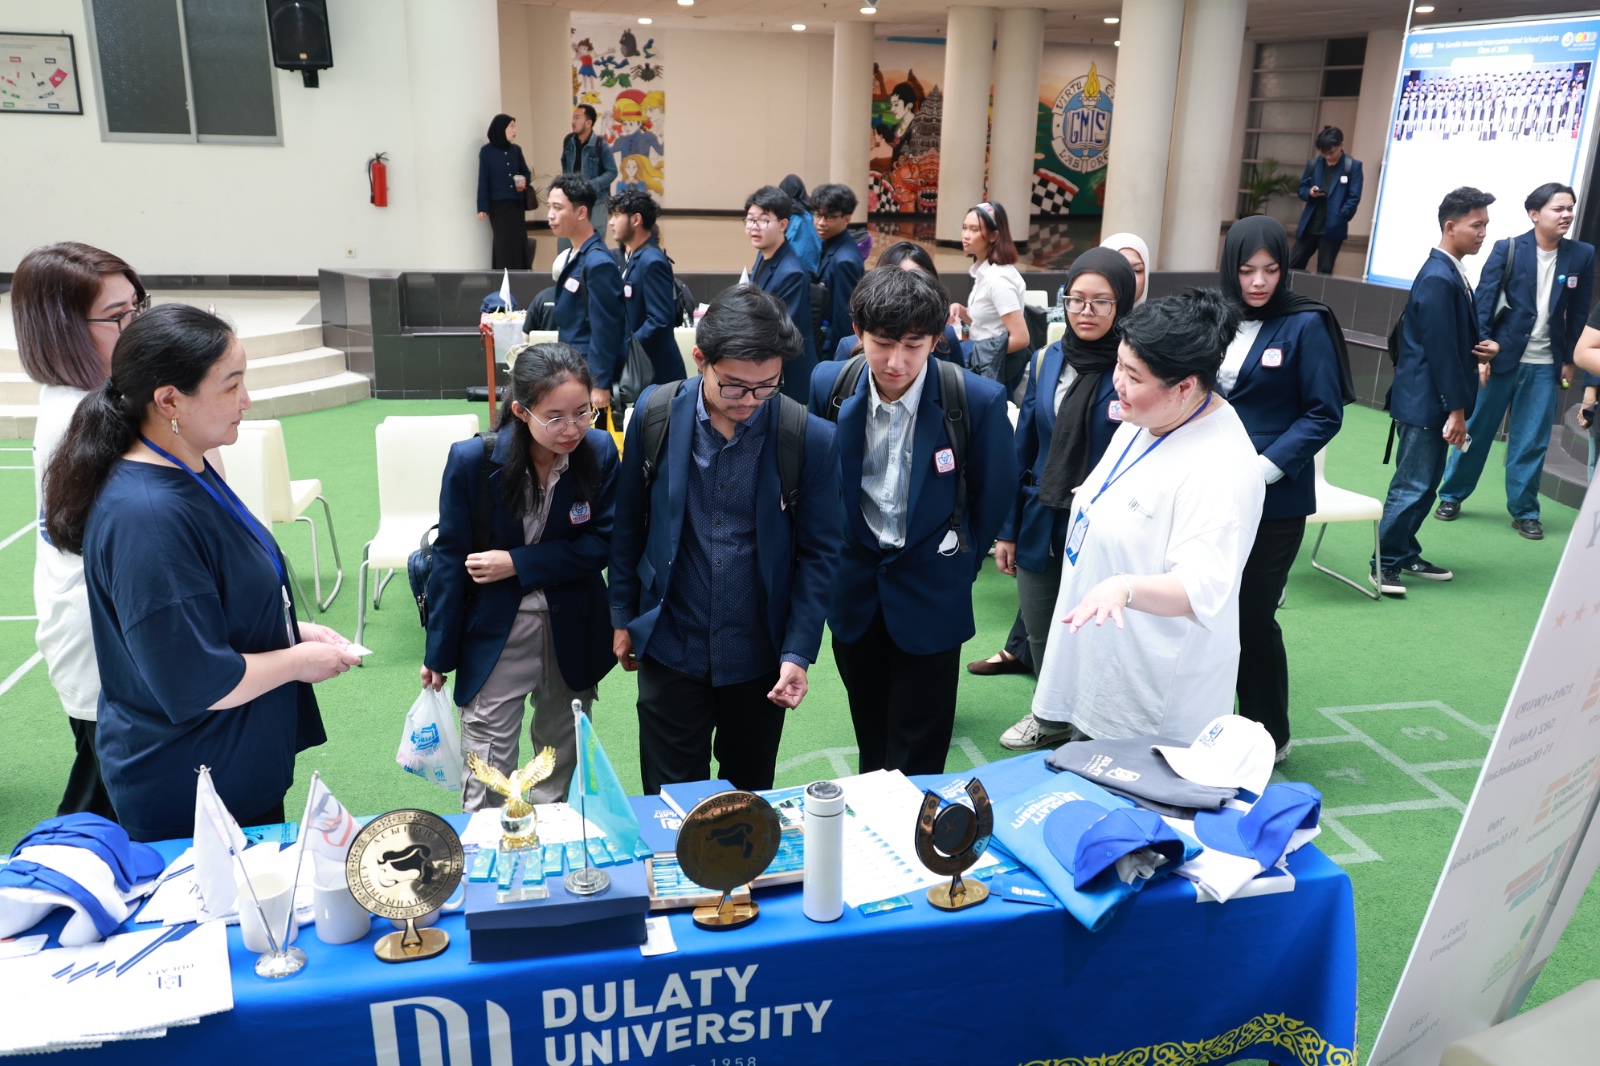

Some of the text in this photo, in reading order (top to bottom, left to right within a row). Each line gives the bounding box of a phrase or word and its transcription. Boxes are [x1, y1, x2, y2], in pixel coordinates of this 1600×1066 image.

[1522, 35, 1539, 46] School
[1539, 34, 1560, 44] Jakarta
[1070, 110, 1106, 144] GMIS
[542, 963, 760, 1030] DULATY
[545, 999, 834, 1066] UNIVERSITY
